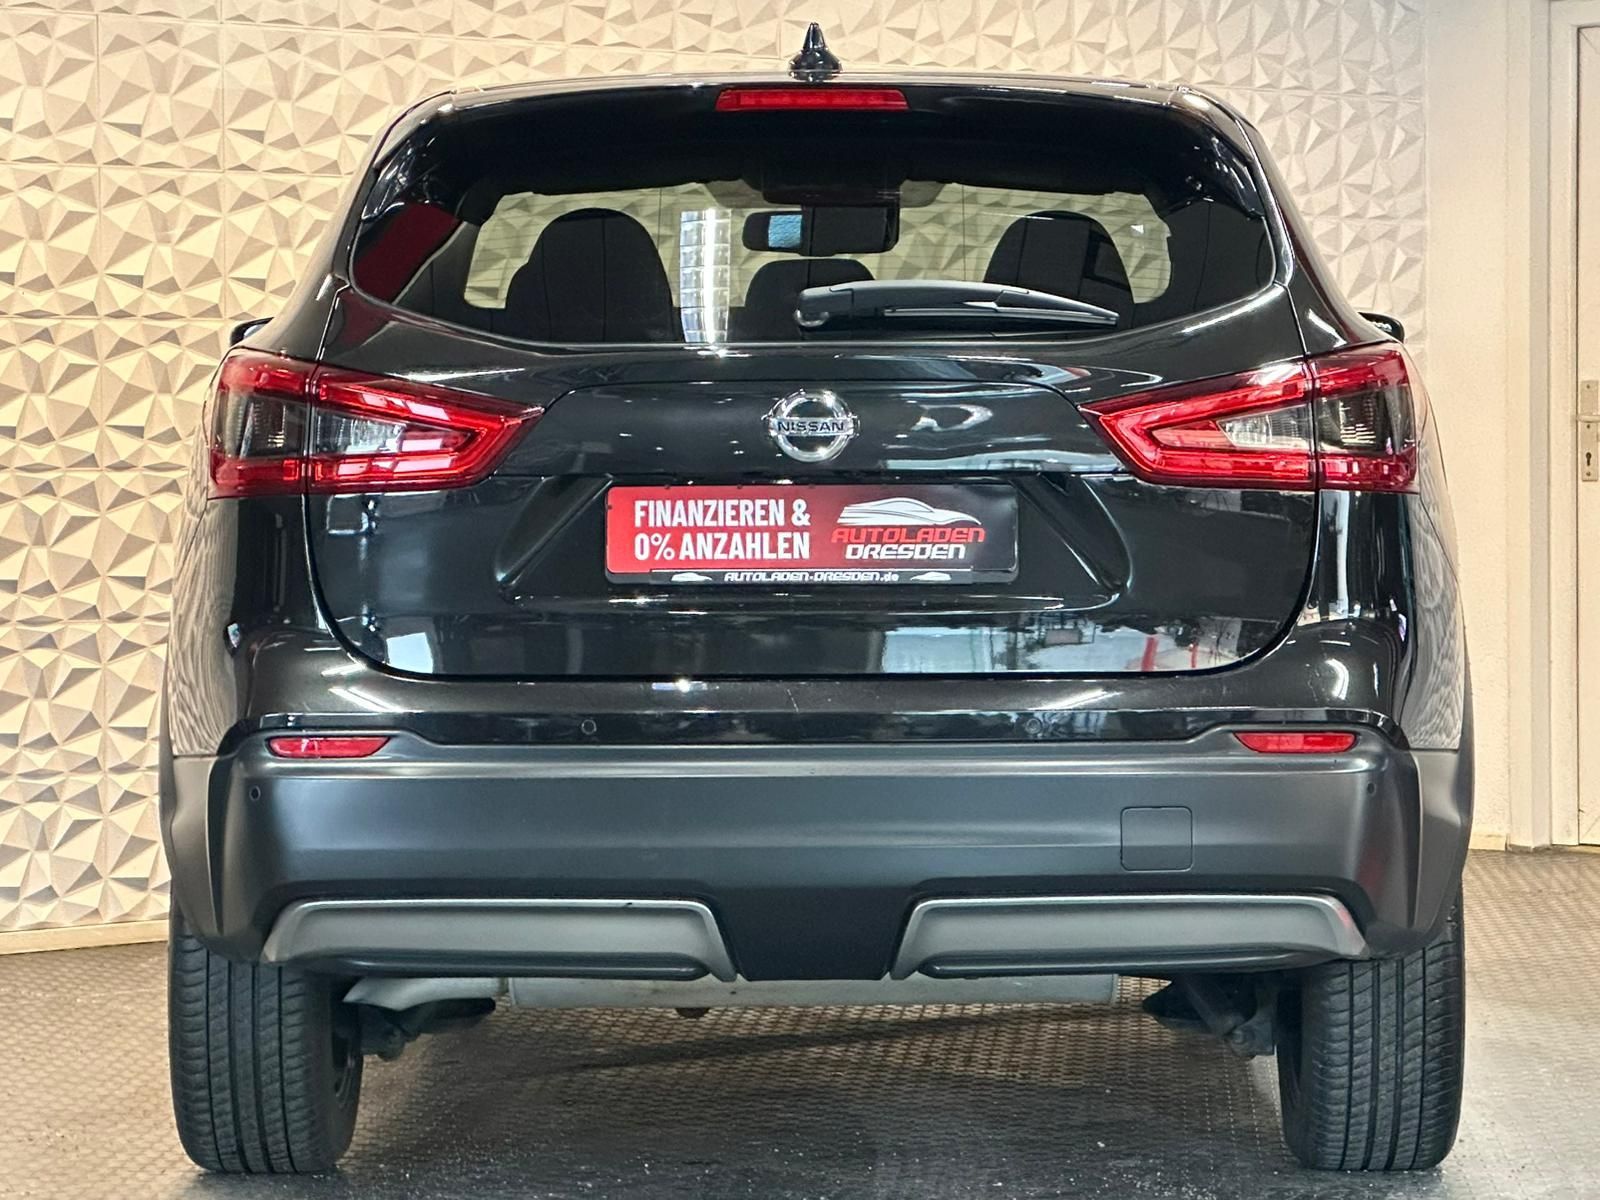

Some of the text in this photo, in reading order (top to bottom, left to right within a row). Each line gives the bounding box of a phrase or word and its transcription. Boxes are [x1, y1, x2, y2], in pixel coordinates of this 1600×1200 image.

[777, 421, 844, 432] NISSAN
[634, 499, 811, 527] FINANZIEREN &
[831, 527, 986, 543] AUTOLADEN
[634, 532, 811, 560] 0% ANZAHLEN
[845, 543, 966, 560] DRESDEN
